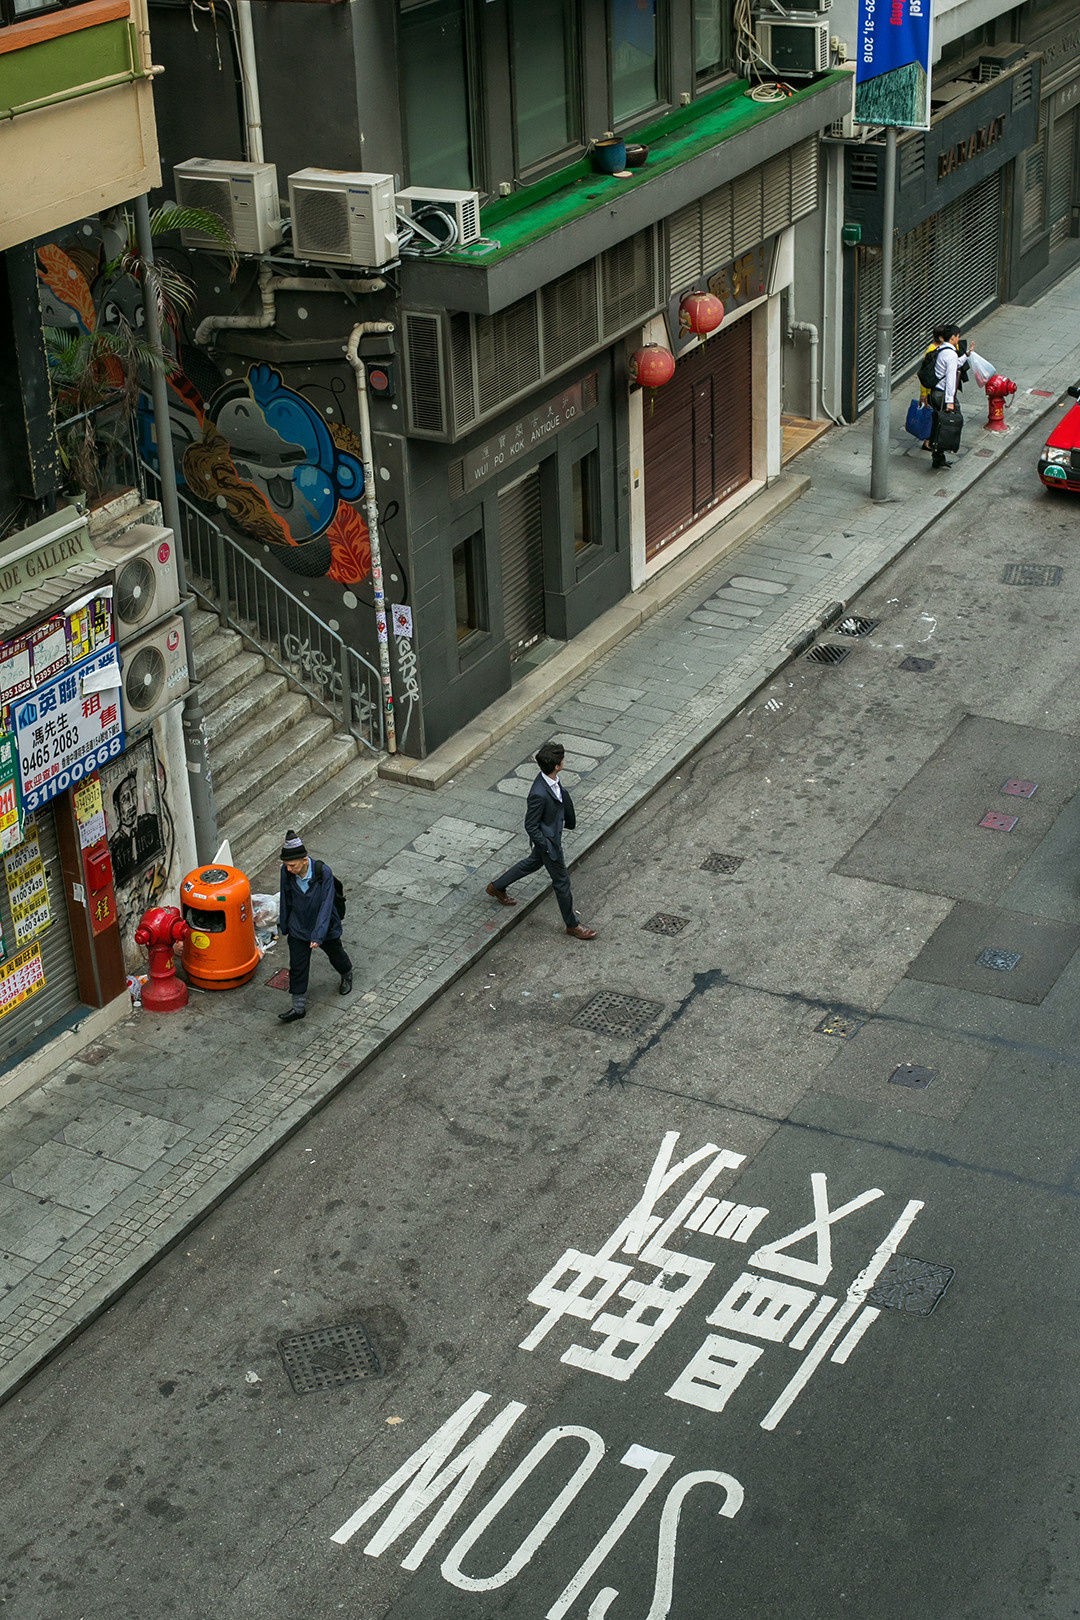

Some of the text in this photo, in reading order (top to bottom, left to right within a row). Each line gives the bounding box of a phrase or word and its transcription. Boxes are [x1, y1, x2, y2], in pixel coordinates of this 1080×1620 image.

[863, 37, 874, 63] 2018
[474, 462, 489, 479] WUI
[494, 452, 504, 467] PO
[509, 439, 525, 456] KOK
[530, 415, 560, 443] ANTIQUE
[25, 533, 85, 578] GALLERY
[14, 679, 31, 695] 1828
[32, 713, 69, 749] 馮先生
[22, 745, 50, 777] 9465
[53, 725, 80, 760] 2083
[26, 737, 122, 812] 31100668
[7, 856, 23, 873] 8100
[12, 888, 27, 905] 8100
[28, 878, 43, 895] 3435
[17, 920, 32, 937] 8100
[33, 910, 48, 927] 3435
[329, 1390, 745, 1620] SLOW
